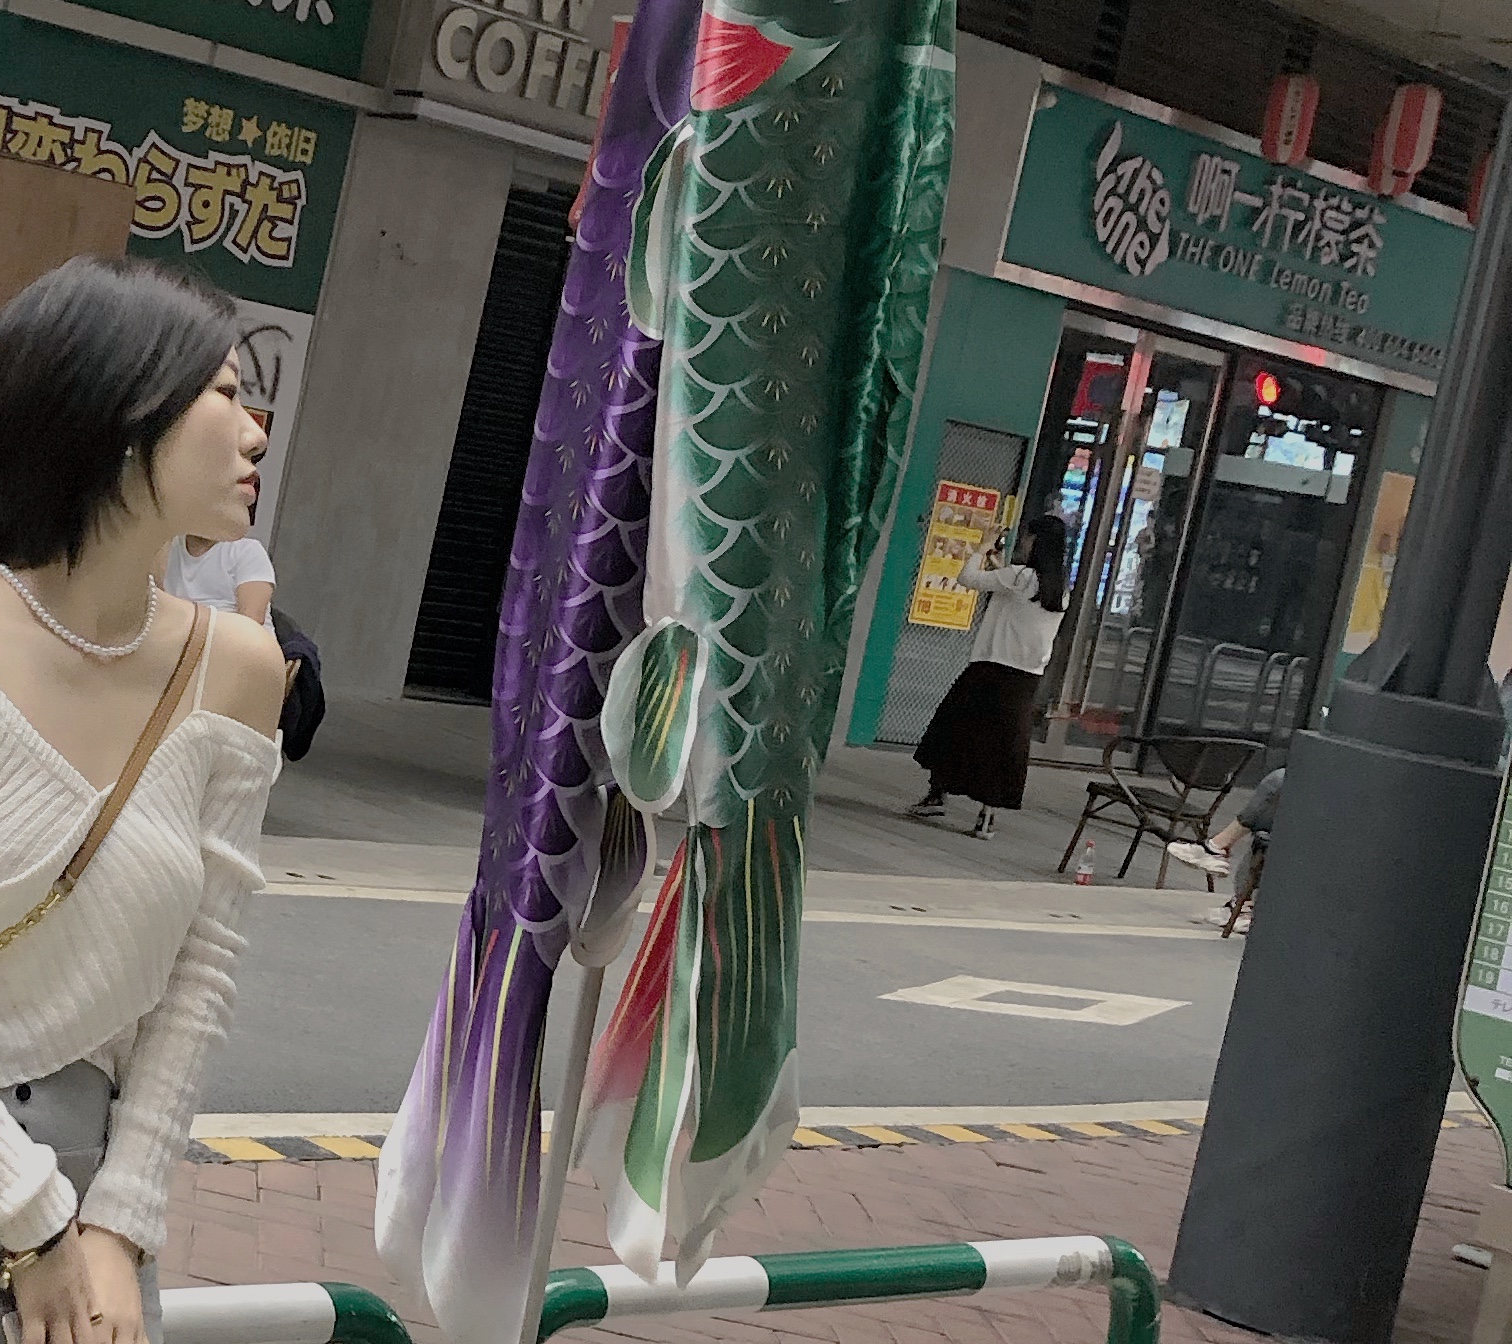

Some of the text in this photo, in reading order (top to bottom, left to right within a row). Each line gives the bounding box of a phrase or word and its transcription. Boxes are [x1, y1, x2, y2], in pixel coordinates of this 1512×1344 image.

[1188, 153, 1387, 278] 啊一柠檬茶
[1177, 231, 1213, 266] THE
[1218, 245, 1263, 282] ONE
[1272, 265, 1333, 303] Lemon
